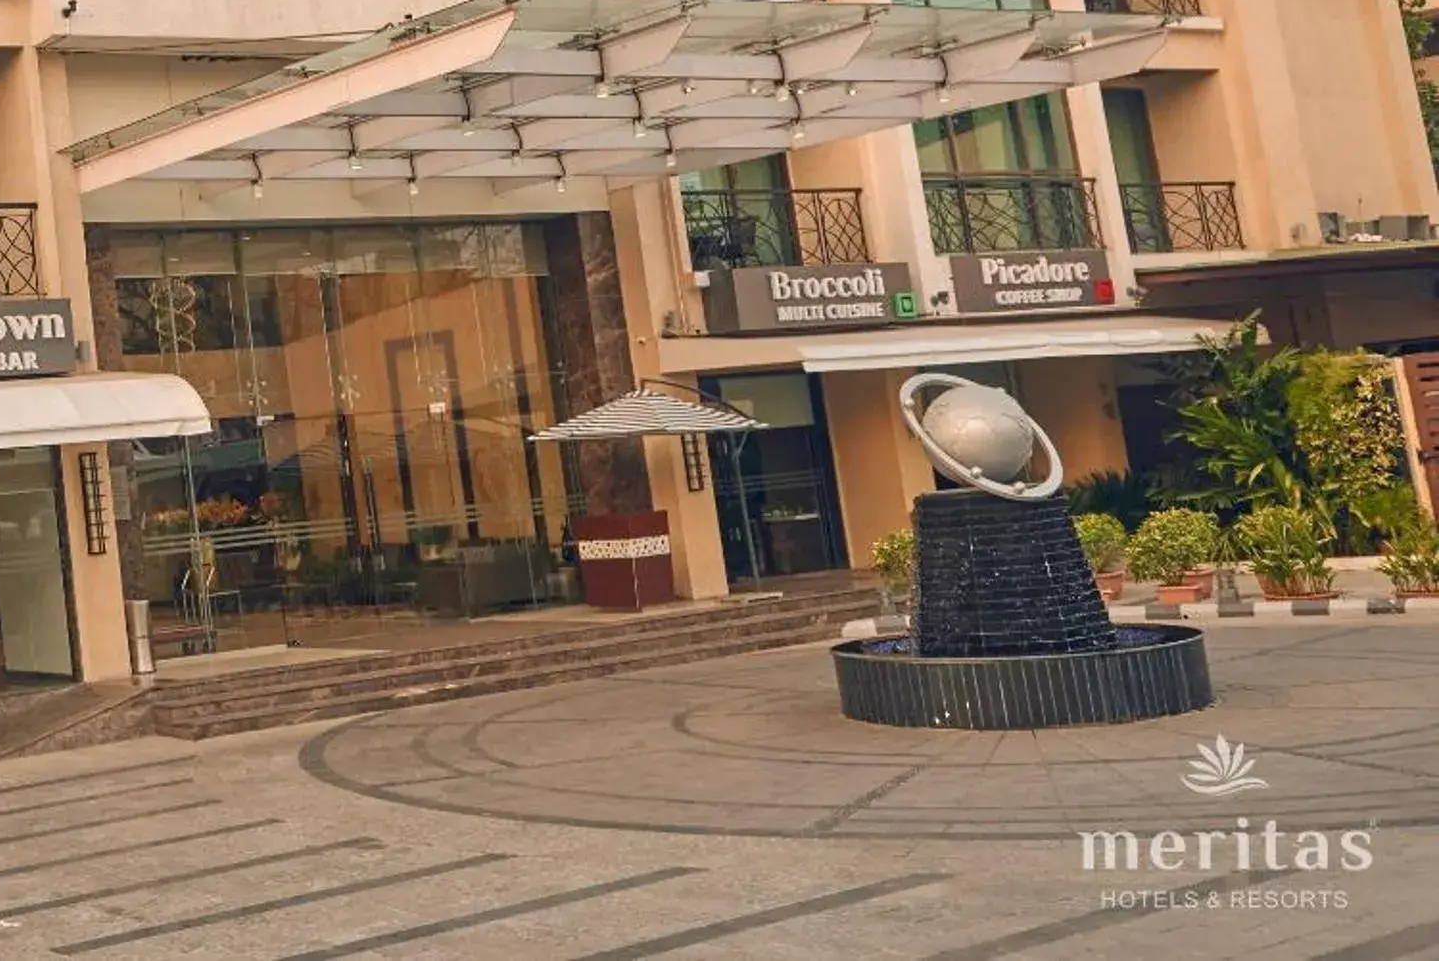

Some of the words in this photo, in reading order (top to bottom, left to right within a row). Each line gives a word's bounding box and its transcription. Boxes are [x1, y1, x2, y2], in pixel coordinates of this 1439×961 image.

[978, 255, 1090, 285] Picadore
[768, 268, 885, 300] Broccoli
[995, 289, 1044, 305] COFFEE
[1046, 287, 1082, 302] SHOP
[776, 305, 824, 322] MULTI
[826, 302, 885, 320] CUISINE
